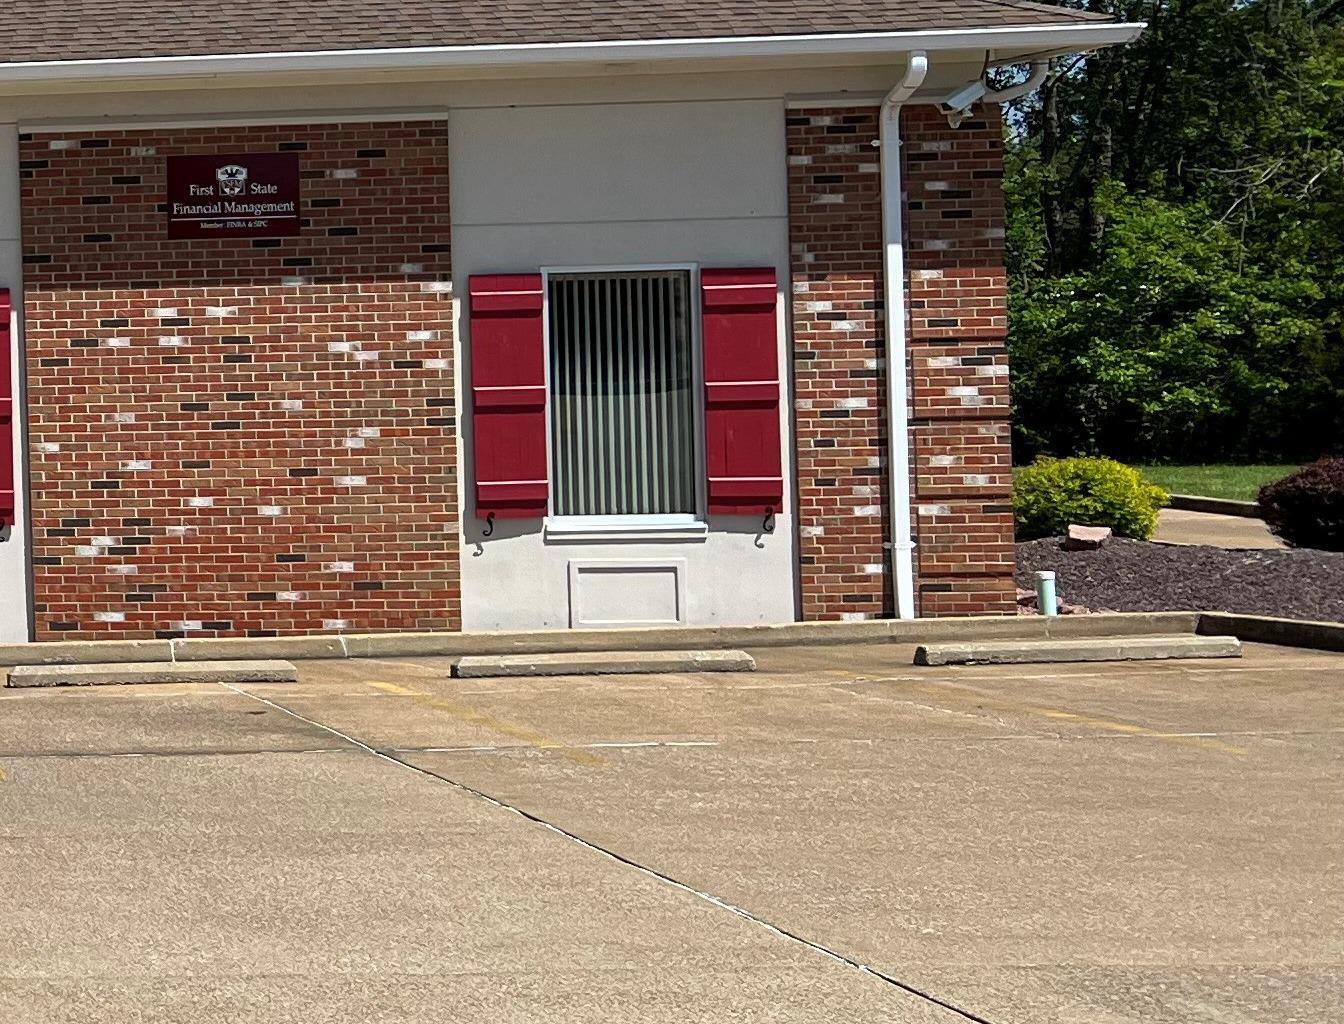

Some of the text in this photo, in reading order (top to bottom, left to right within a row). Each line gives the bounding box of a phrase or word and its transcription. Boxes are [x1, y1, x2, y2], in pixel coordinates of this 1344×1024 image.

[189, 182, 278, 196] First State
[173, 201, 295, 215] Financial Management
